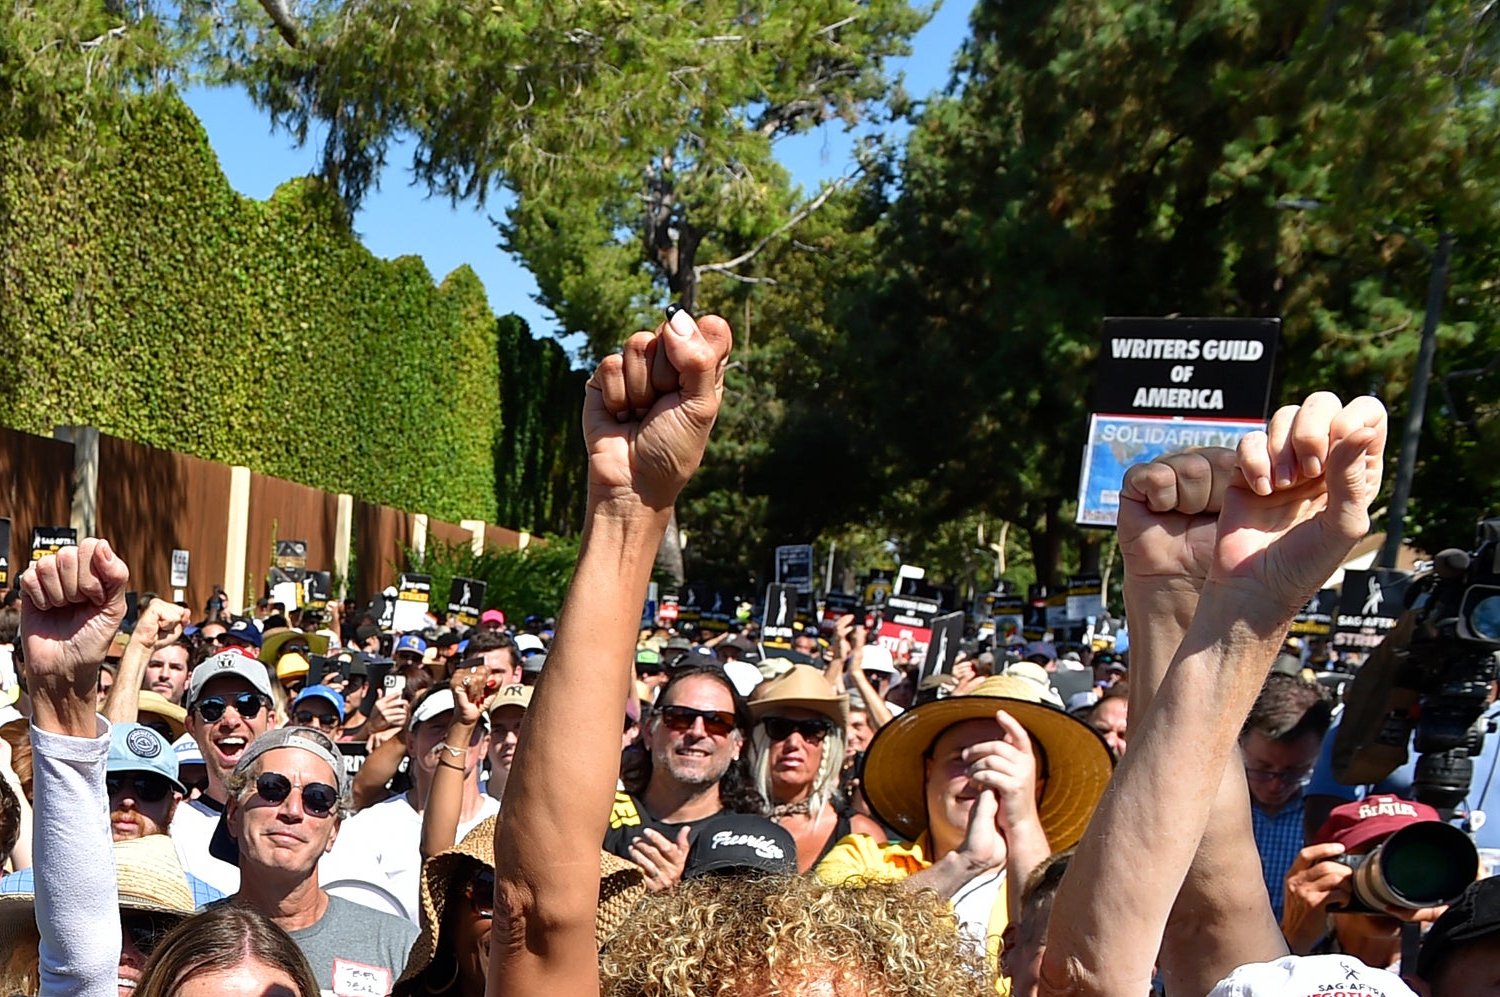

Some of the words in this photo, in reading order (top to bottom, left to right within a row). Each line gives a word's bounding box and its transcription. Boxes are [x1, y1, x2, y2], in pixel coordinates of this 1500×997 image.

[1111, 338, 1200, 360] WRITERS
[1202, 340, 1264, 361] GUILD
[1170, 365, 1194, 383] OF
[1132, 387, 1224, 409] AMERICA
